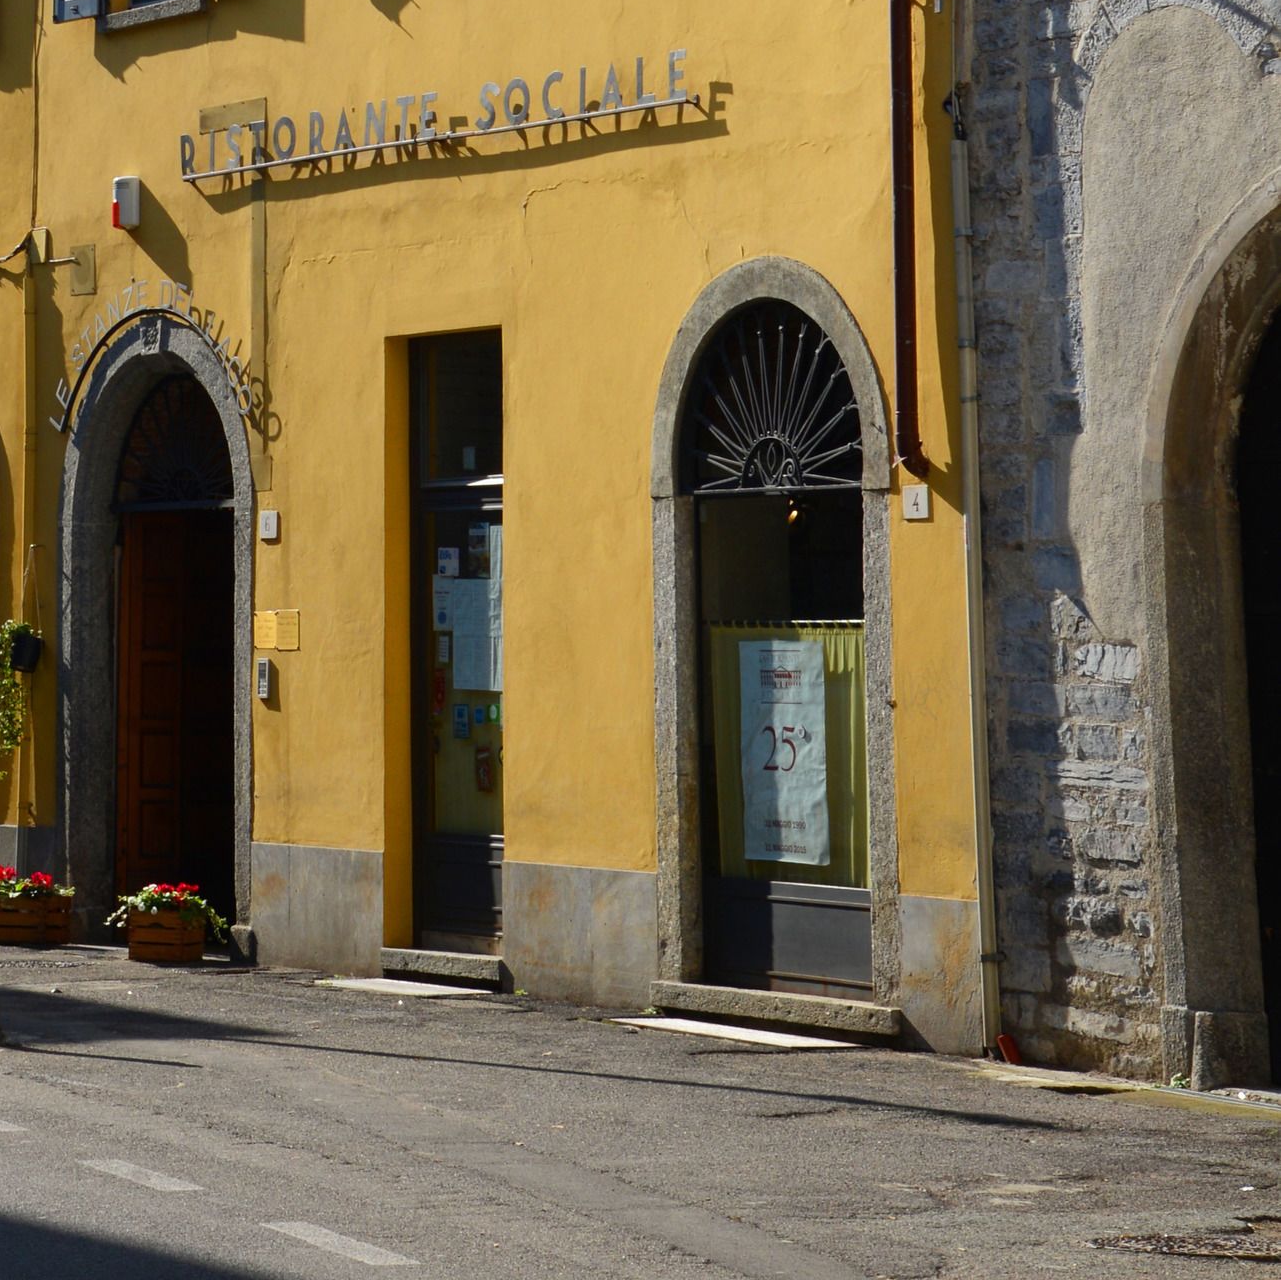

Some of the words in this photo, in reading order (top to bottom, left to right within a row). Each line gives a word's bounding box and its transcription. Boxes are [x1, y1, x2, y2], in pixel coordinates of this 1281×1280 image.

[180, 92, 438, 176] RISTORANTE
[475, 48, 688, 131] SOCIALE
[49, 378, 73, 432] LE
[72, 279, 148, 371] STANZE
[160, 279, 194, 316] DEL
[264, 516, 271, 532] 6
[912, 491, 920, 512] 4
